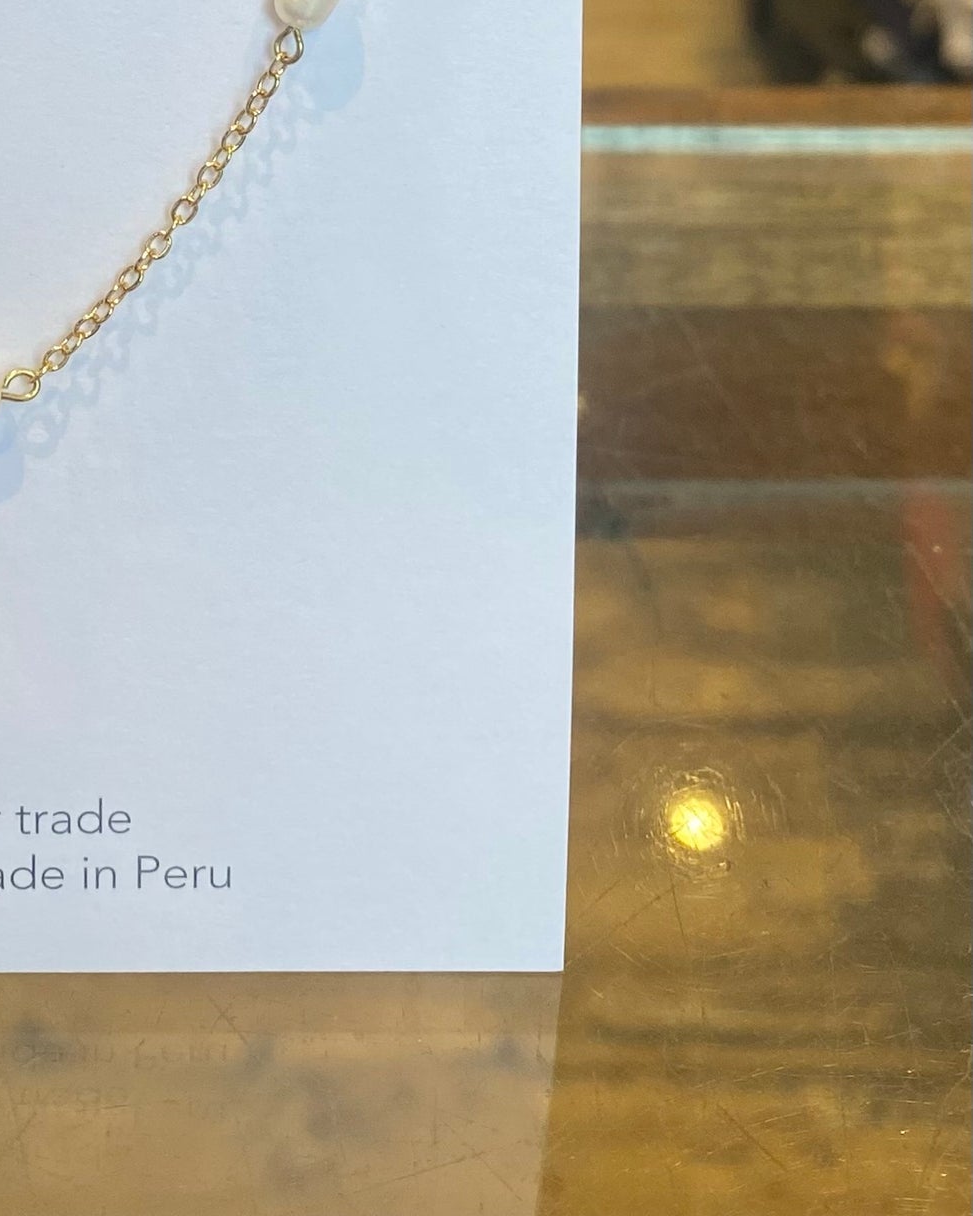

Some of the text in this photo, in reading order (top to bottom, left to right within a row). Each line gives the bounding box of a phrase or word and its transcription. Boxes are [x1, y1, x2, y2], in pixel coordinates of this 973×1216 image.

[14, 797, 132, 835] trade
[82, 857, 117, 890] in
[136, 855, 232, 890] Peru
